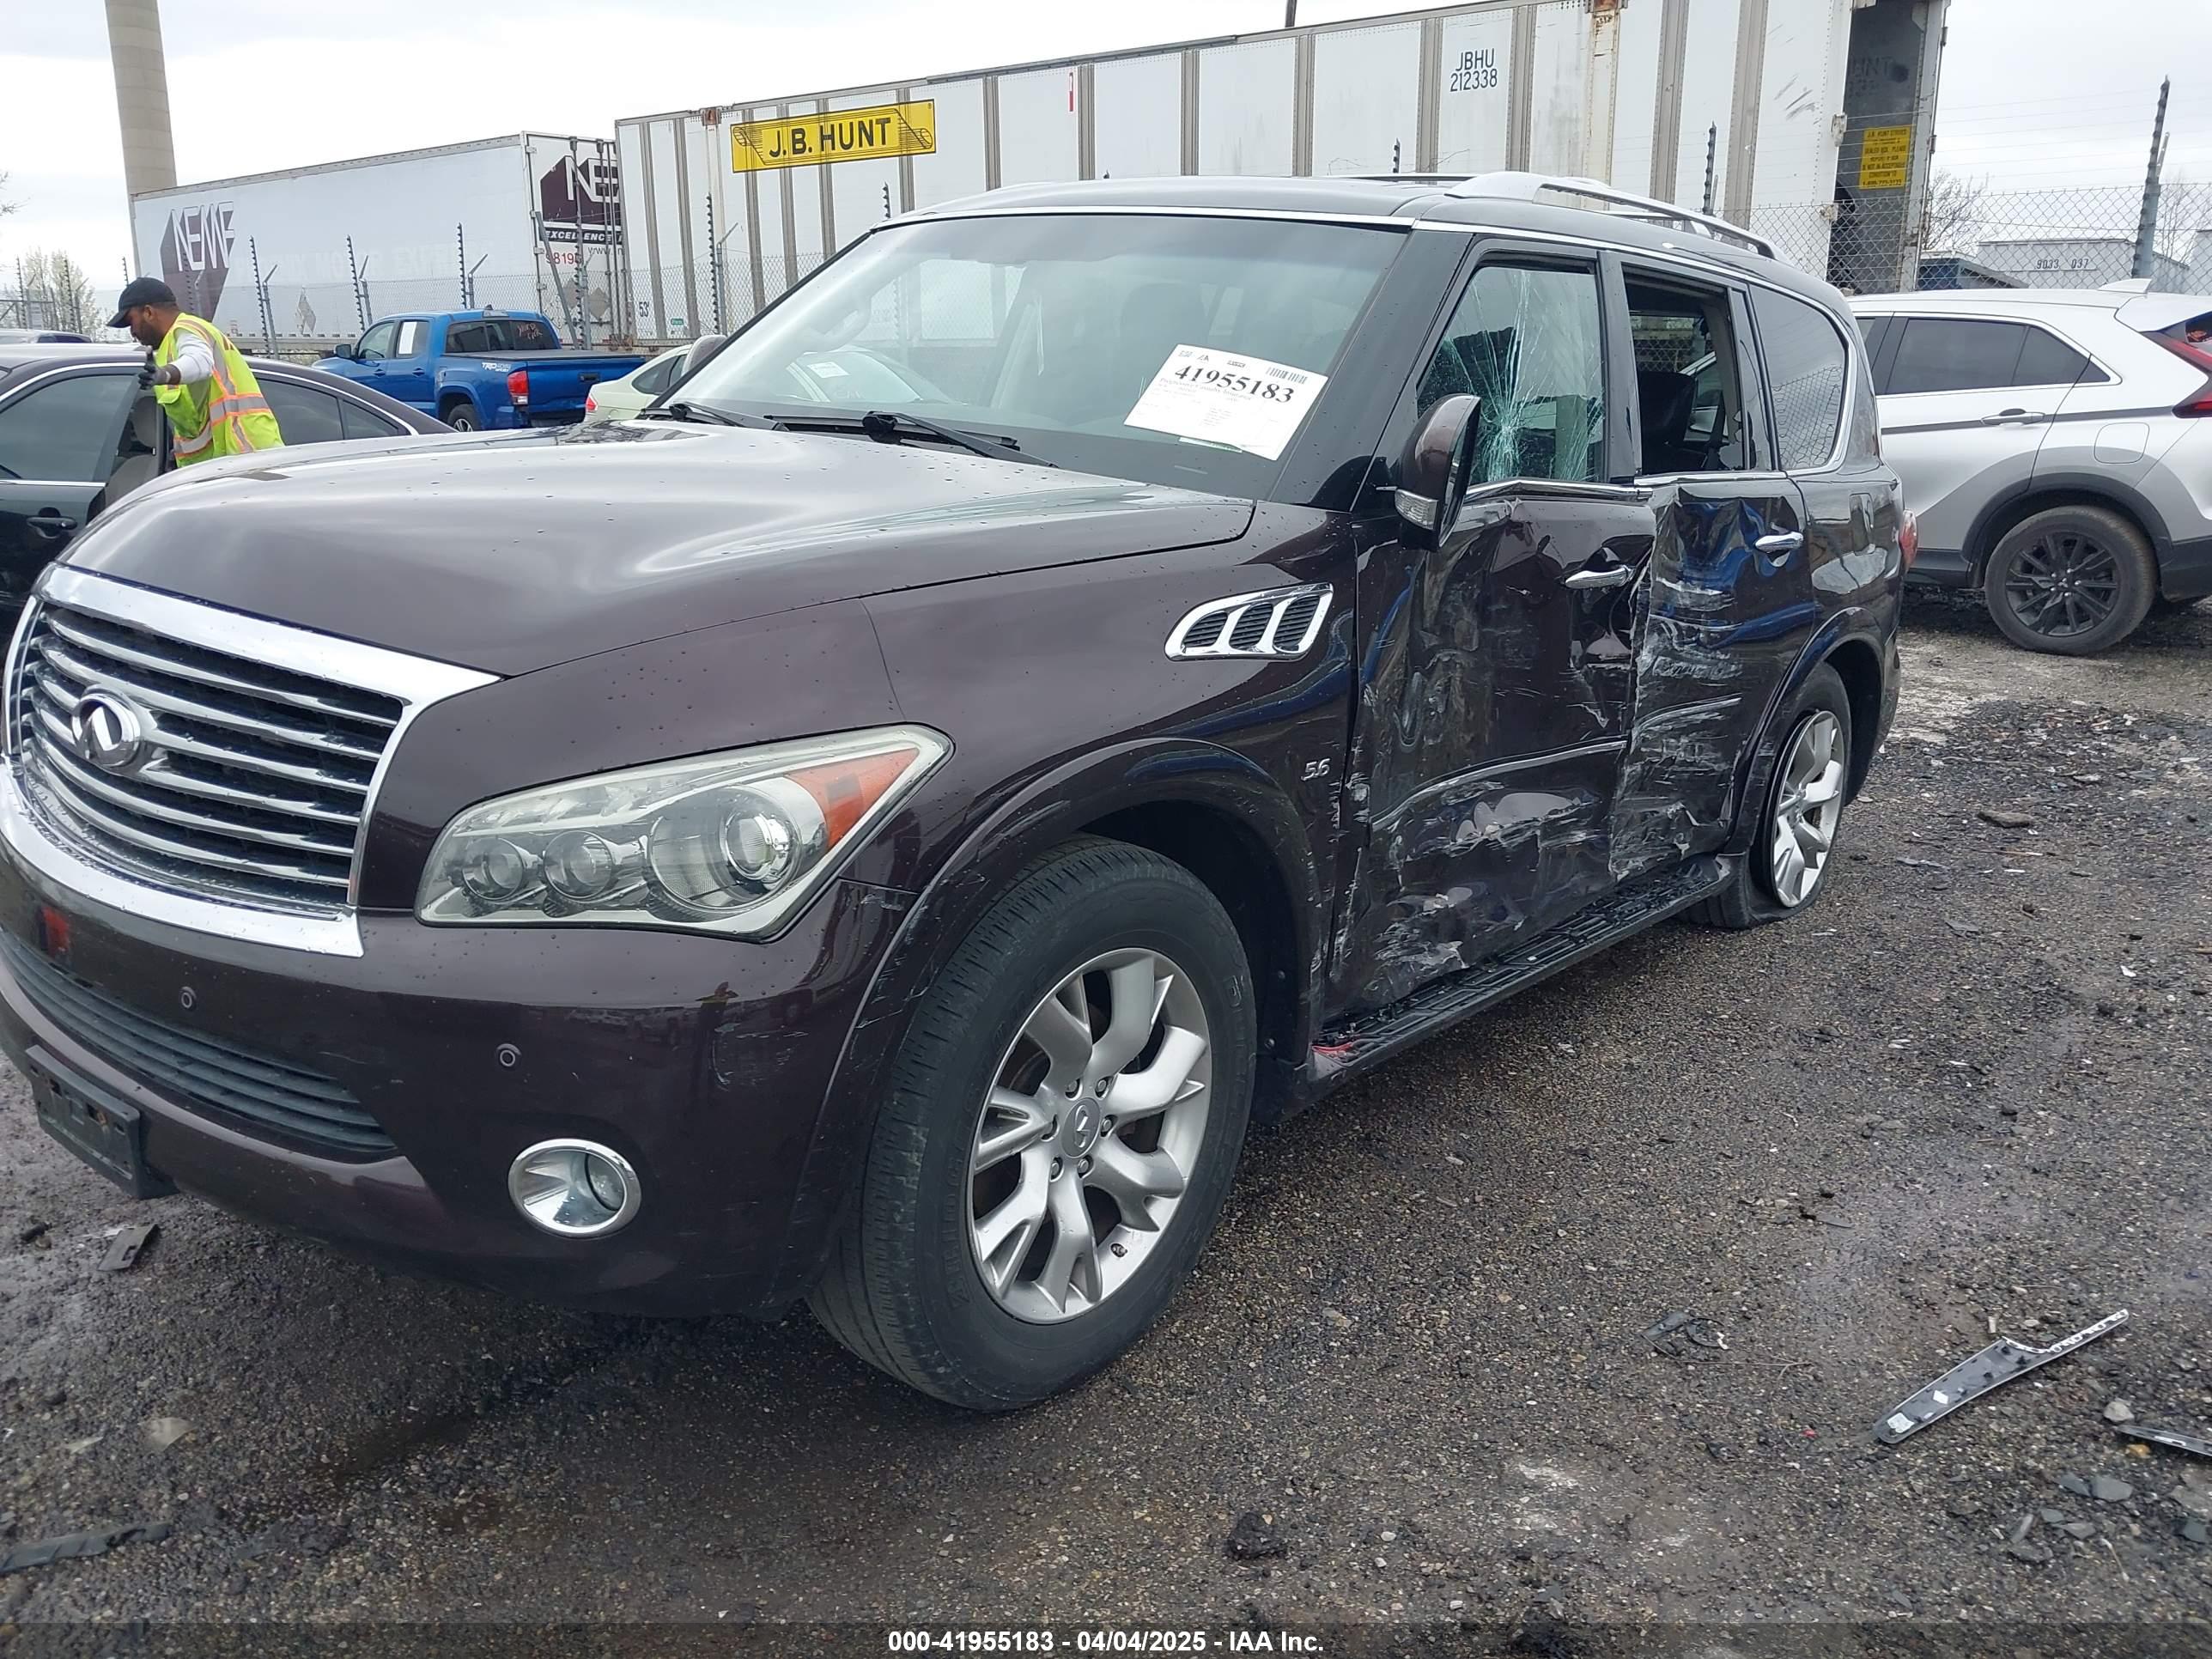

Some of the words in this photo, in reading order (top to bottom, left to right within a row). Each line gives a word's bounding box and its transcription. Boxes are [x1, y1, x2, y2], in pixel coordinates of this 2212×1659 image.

[1455, 48, 1494, 71] JBHU
[1450, 69, 1498, 92] 212338
[769, 127, 813, 158] J.B.
[820, 117, 891, 152] HUNT
[545, 230, 612, 242] EXCELENCE
[2037, 258, 2059, 270] 9033
[2071, 258, 2089, 269] 037
[1175, 365, 1295, 404] 41955183
